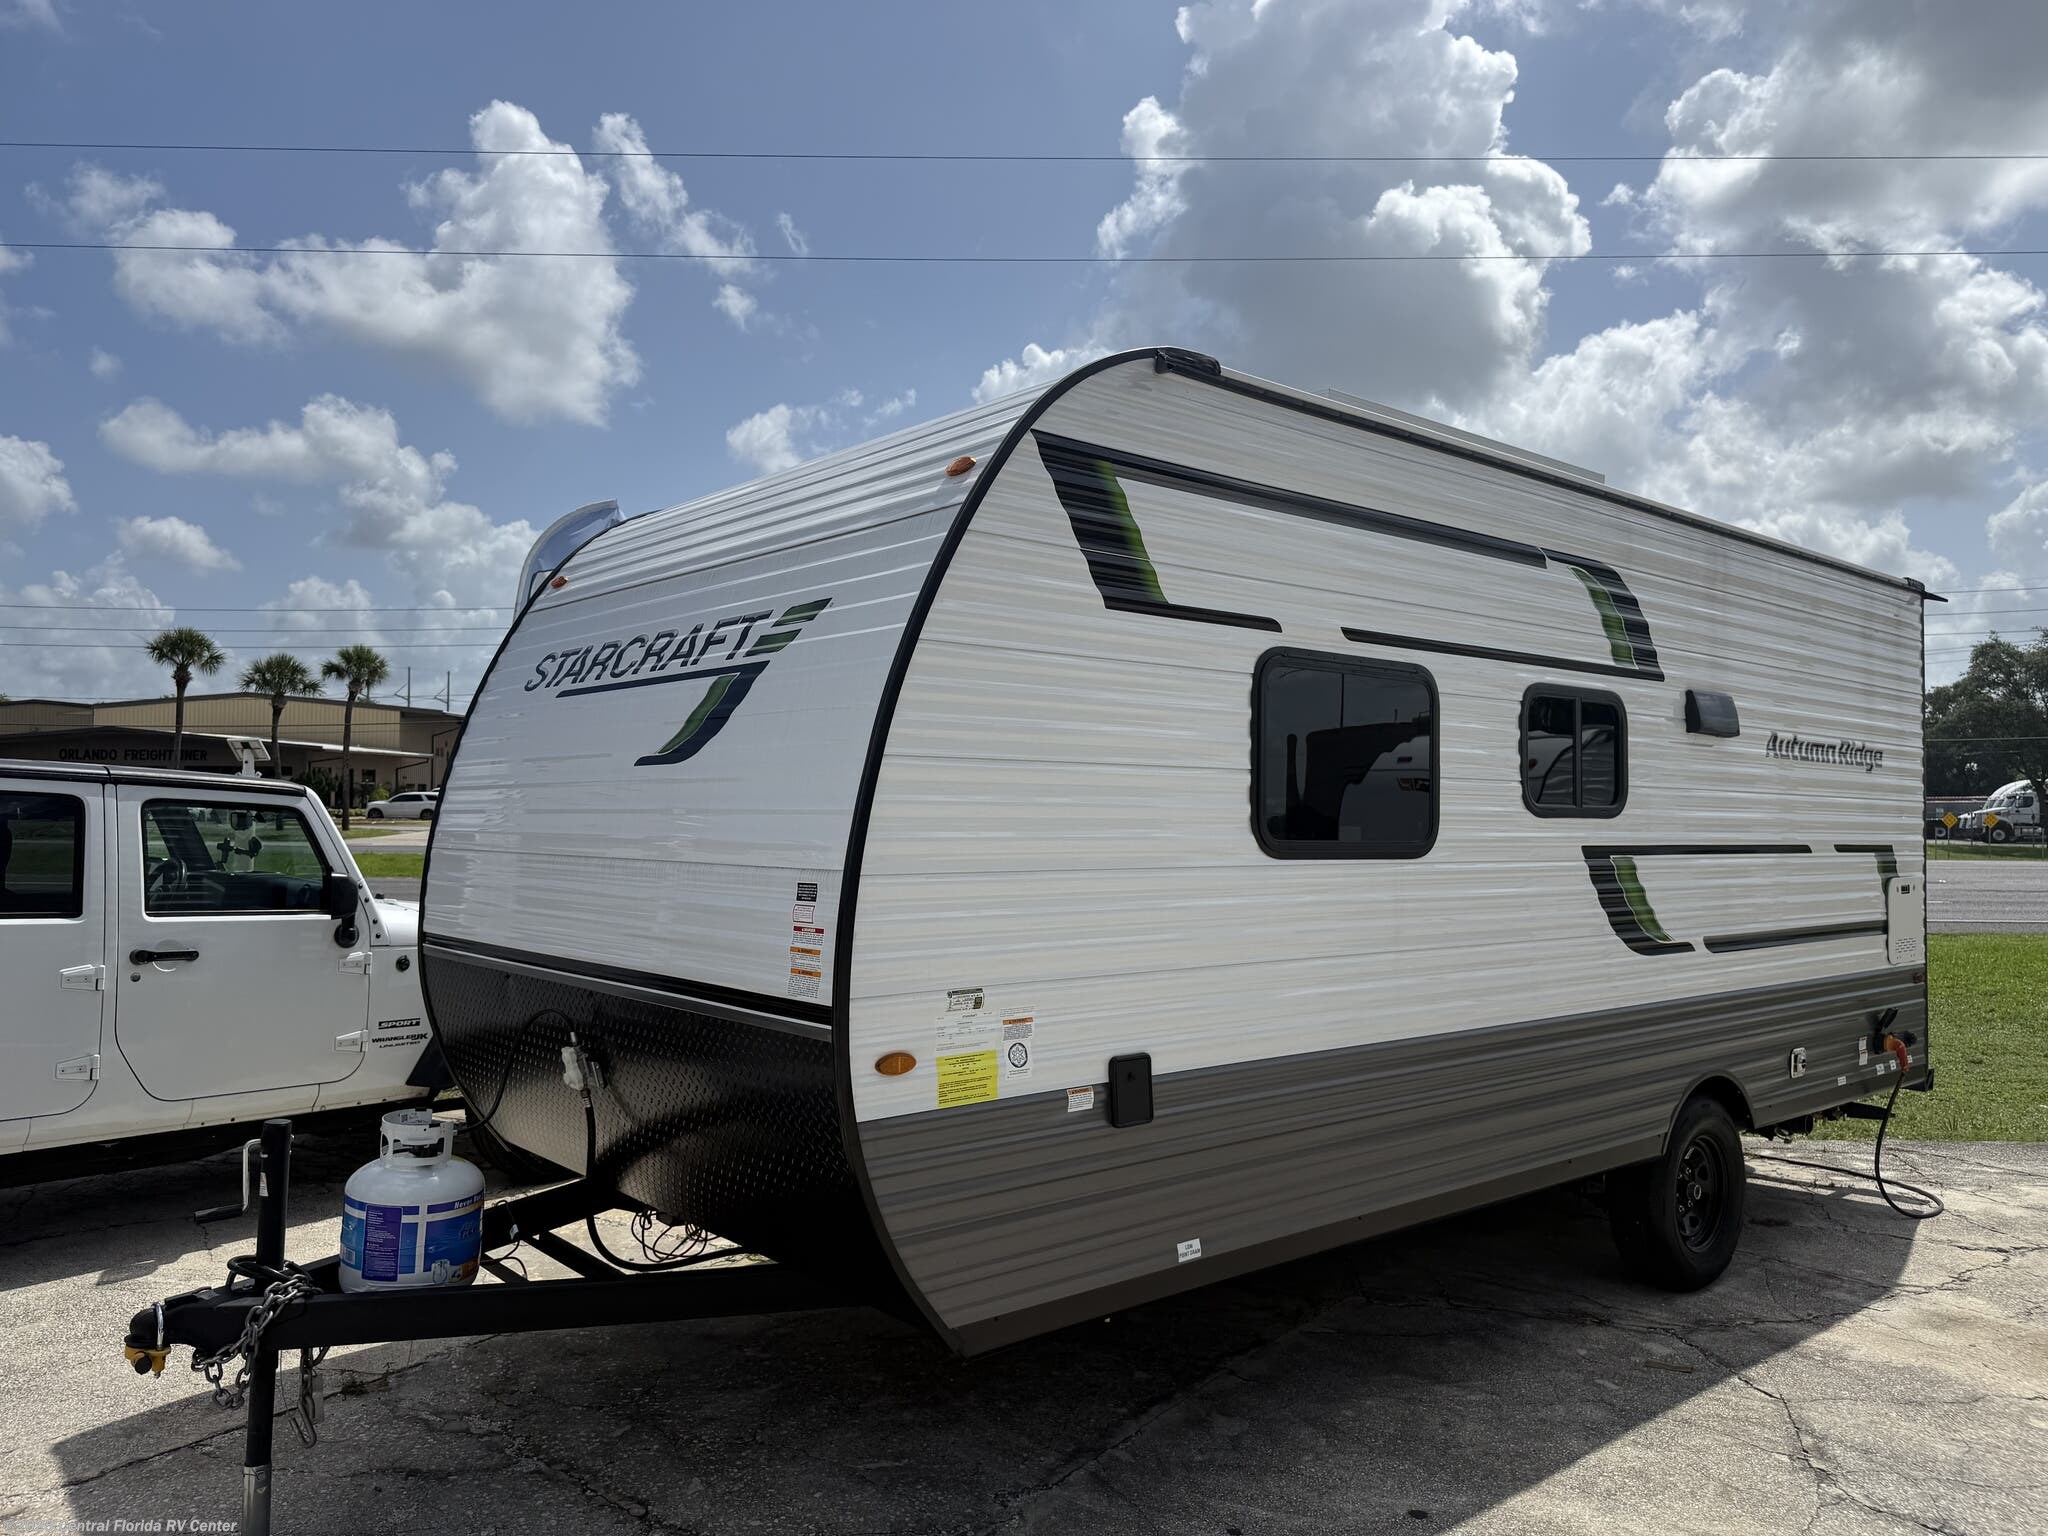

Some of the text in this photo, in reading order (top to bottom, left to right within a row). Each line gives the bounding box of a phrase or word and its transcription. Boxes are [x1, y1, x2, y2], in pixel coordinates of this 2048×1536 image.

[524, 610, 773, 692] STARCRAFT
[59, 748, 208, 761] ORLANDO FREIGHTINER
